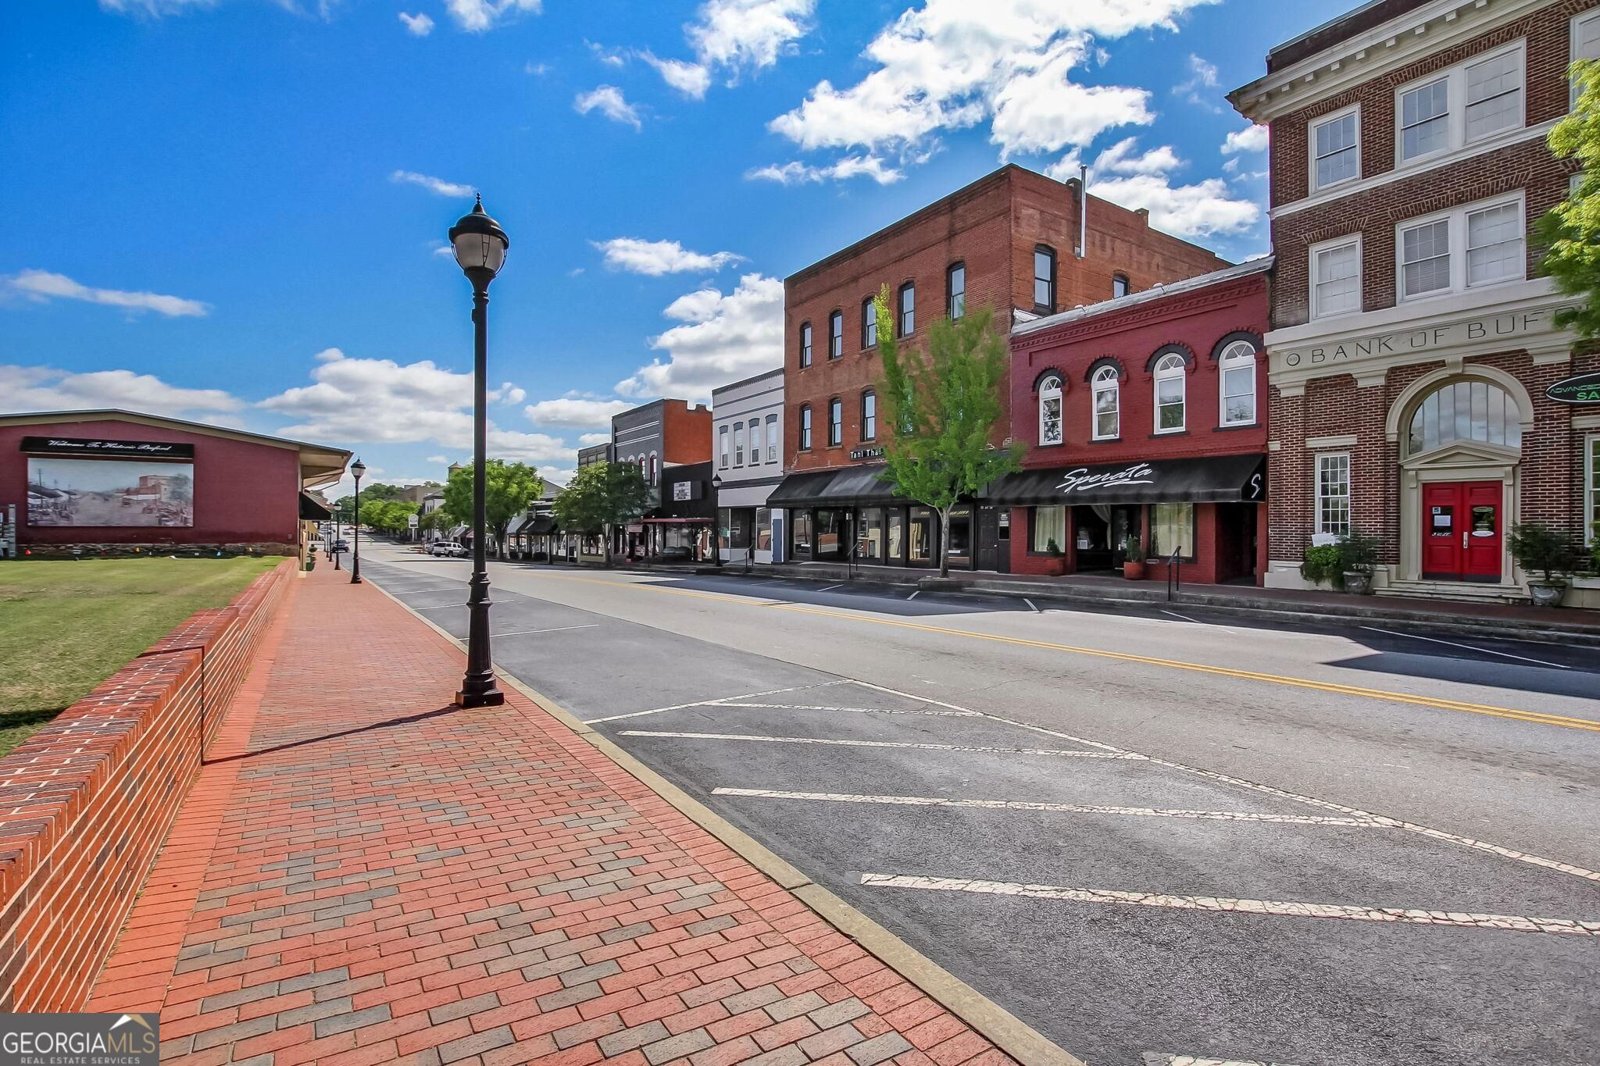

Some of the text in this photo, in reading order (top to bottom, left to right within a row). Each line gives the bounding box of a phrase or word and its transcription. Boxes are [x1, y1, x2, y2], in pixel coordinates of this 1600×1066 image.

[1311, 304, 1589, 363] BANK OF BUF
[48, 439, 85, 447] Welcome
